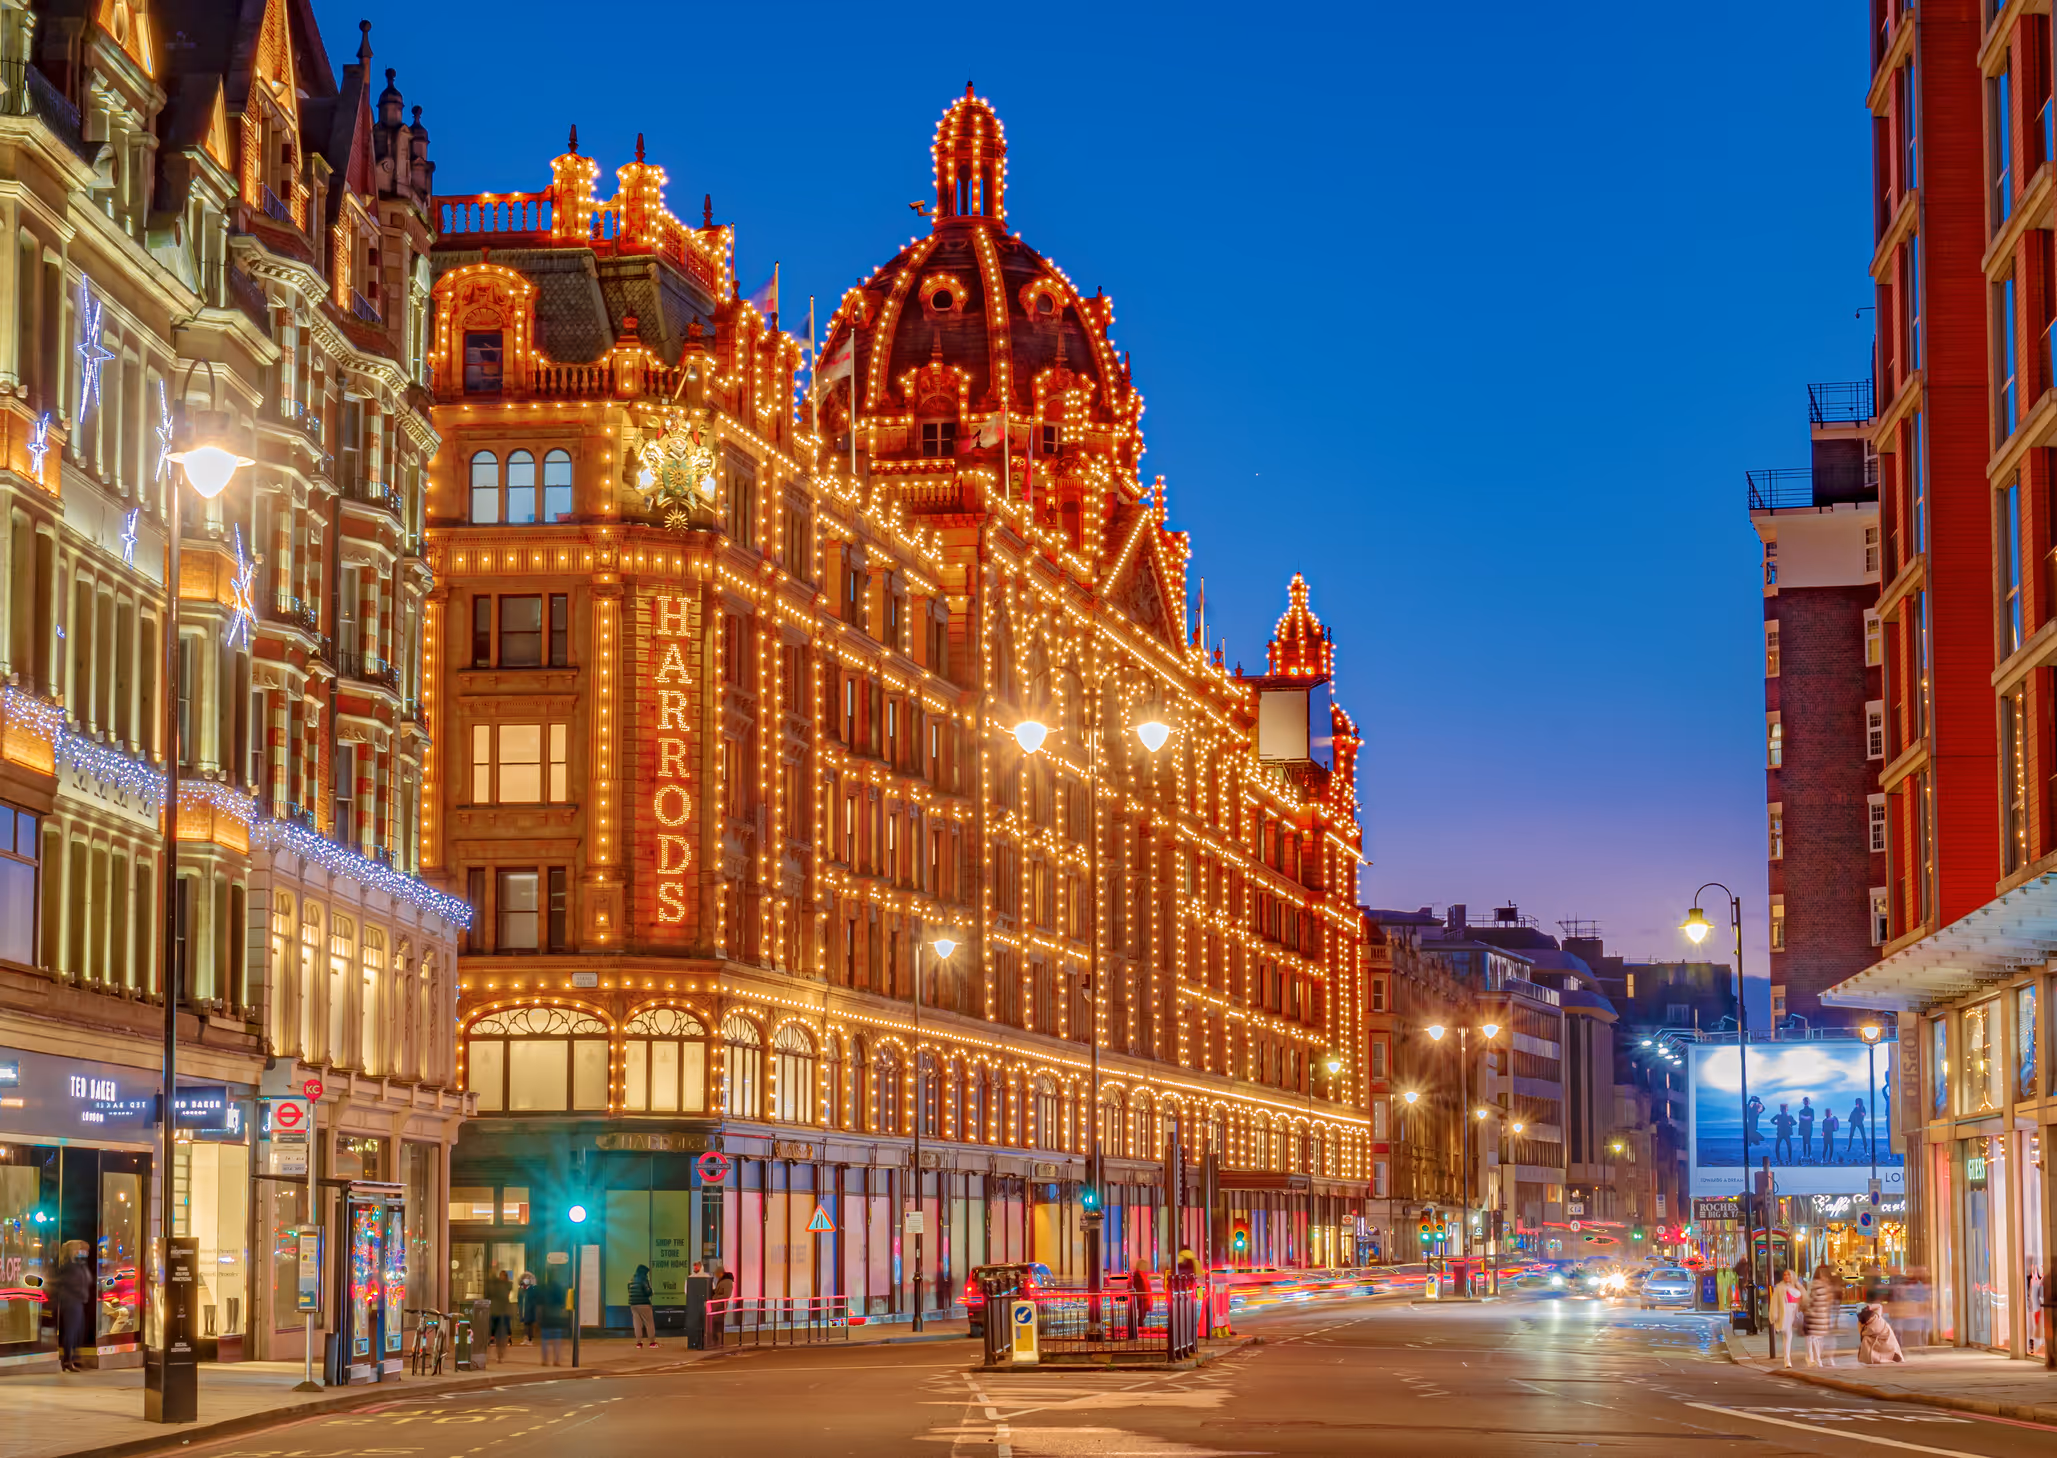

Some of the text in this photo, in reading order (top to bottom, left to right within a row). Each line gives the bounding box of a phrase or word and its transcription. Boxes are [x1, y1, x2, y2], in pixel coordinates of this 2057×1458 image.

[654, 595, 692, 923] HARRODS
[1902, 1025, 1919, 1112] TOPSHO
[71, 1075, 116, 1102] TED BAKER
[306, 1085, 320, 1094] KC
[191, 1101, 220, 1109] BAKER
[82, 1111, 104, 1122] LONDON
[1967, 1158, 1986, 1180] GUESS
[656, 1239, 685, 1247] SHOP THE
[661, 1249, 679, 1258] STORE
[6, 1258, 21, 1281] OFF
[652, 1260, 688, 1269] FROM HOME
[662, 1281, 677, 1290] Visit
[208, 1446, 425, 1458] BUS
